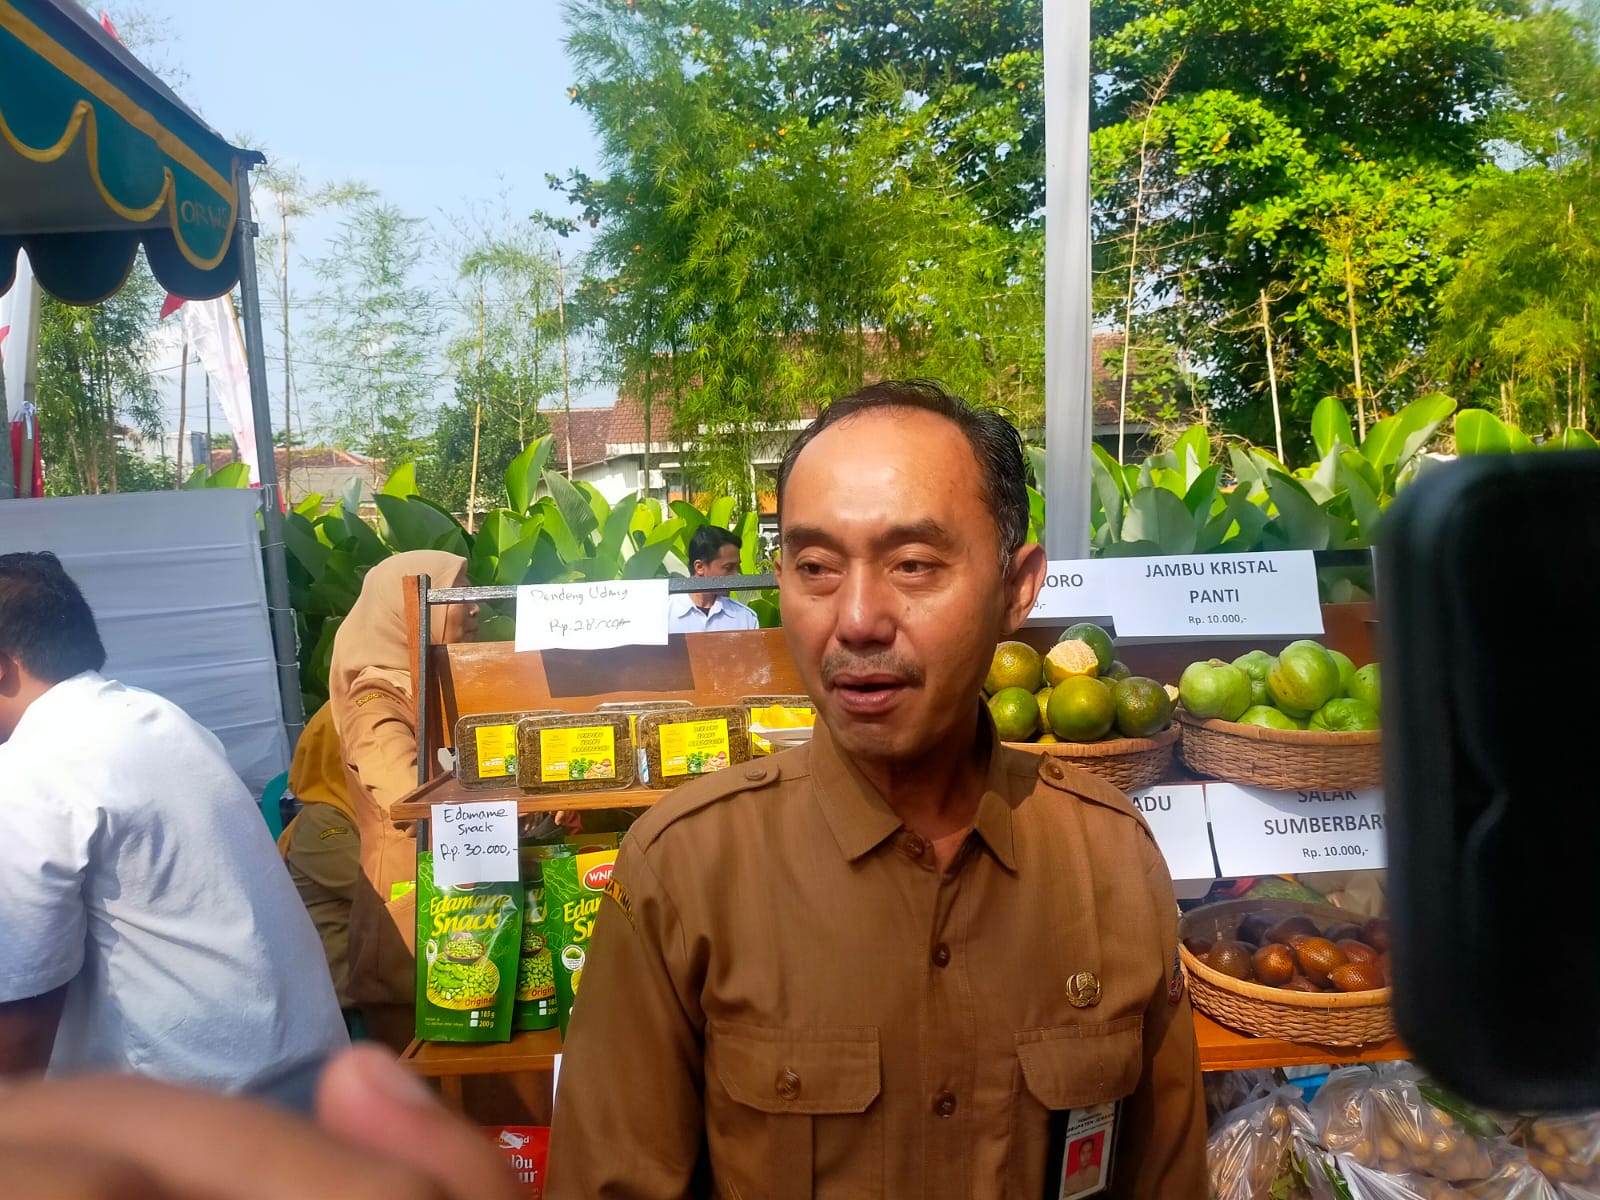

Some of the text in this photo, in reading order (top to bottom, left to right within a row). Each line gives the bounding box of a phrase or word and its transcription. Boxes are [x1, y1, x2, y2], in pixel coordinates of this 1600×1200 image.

[1145, 559, 1278, 578] JAMBU KRISTAL
[1189, 588, 1240, 604] PANTI
[1188, 614, 1247, 626] Rp. 10.000,-
[443, 806, 509, 823] Edamame
[457, 822, 494, 836] Snack
[1264, 813, 1387, 836] SUMBERBAR
[440, 843, 519, 862] Rp. 30.000,-
[1302, 845, 1369, 859] Rp. 10.000,-
[430, 893, 512, 916] Edamame
[431, 908, 502, 937] Snack
